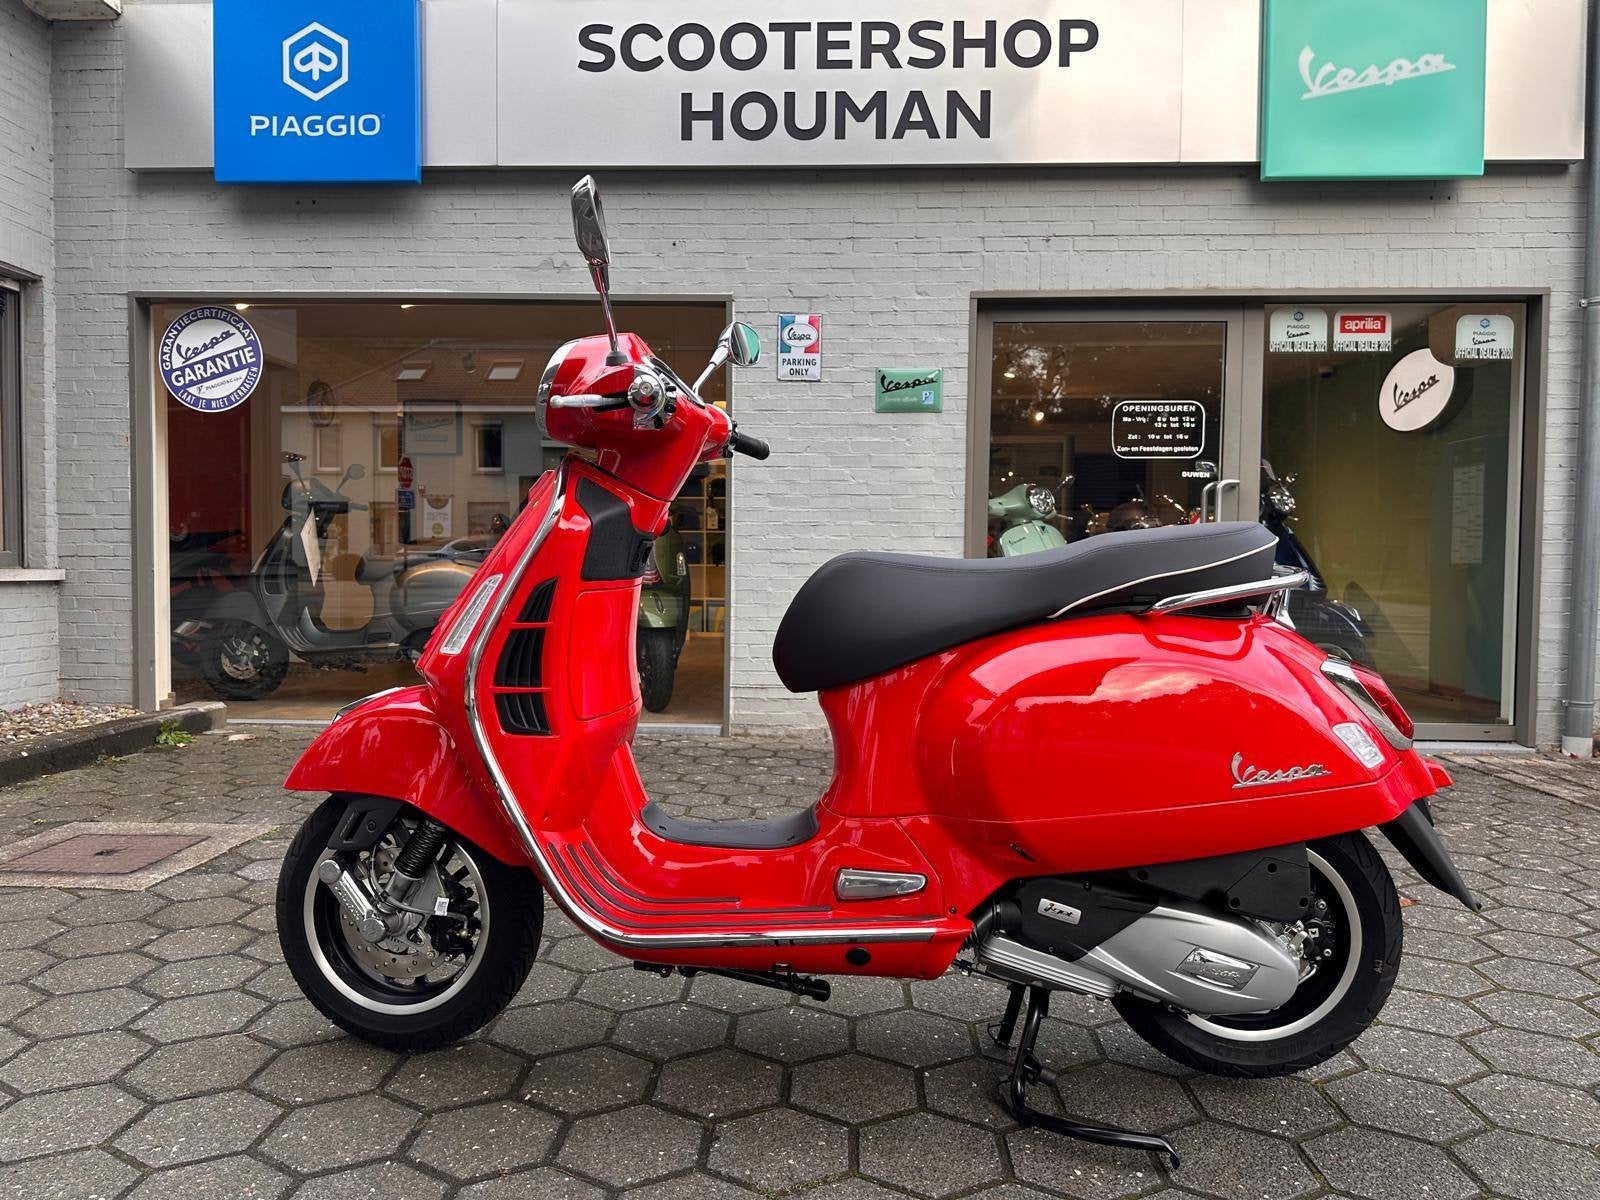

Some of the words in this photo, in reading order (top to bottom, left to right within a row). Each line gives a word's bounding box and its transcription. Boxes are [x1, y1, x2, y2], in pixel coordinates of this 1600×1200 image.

[577, 18, 1099, 73] SCOOTERSHOP
[1298, 45, 1456, 100] Vespa
[250, 113, 382, 137] PIAGGIO
[680, 89, 992, 142] HOUMAN
[162, 308, 255, 371] GARANTIECERTIFICAAT
[787, 327, 812, 341] Vespa
[1344, 317, 1381, 331] aprilia
[171, 346, 257, 387] GARANTIE
[175, 329, 237, 365] Vespa
[782, 358, 817, 366] PARKING
[178, 389, 198, 405] LAAT
[197, 399, 207, 409] JE
[211, 397, 229, 409] NIET
[229, 366, 259, 403] VERRASSEN
[789, 368, 810, 376] ONLY
[880, 374, 938, 394] Vespa
[1393, 373, 1441, 413] Vespa
[1231, 751, 1333, 790] Vespa
